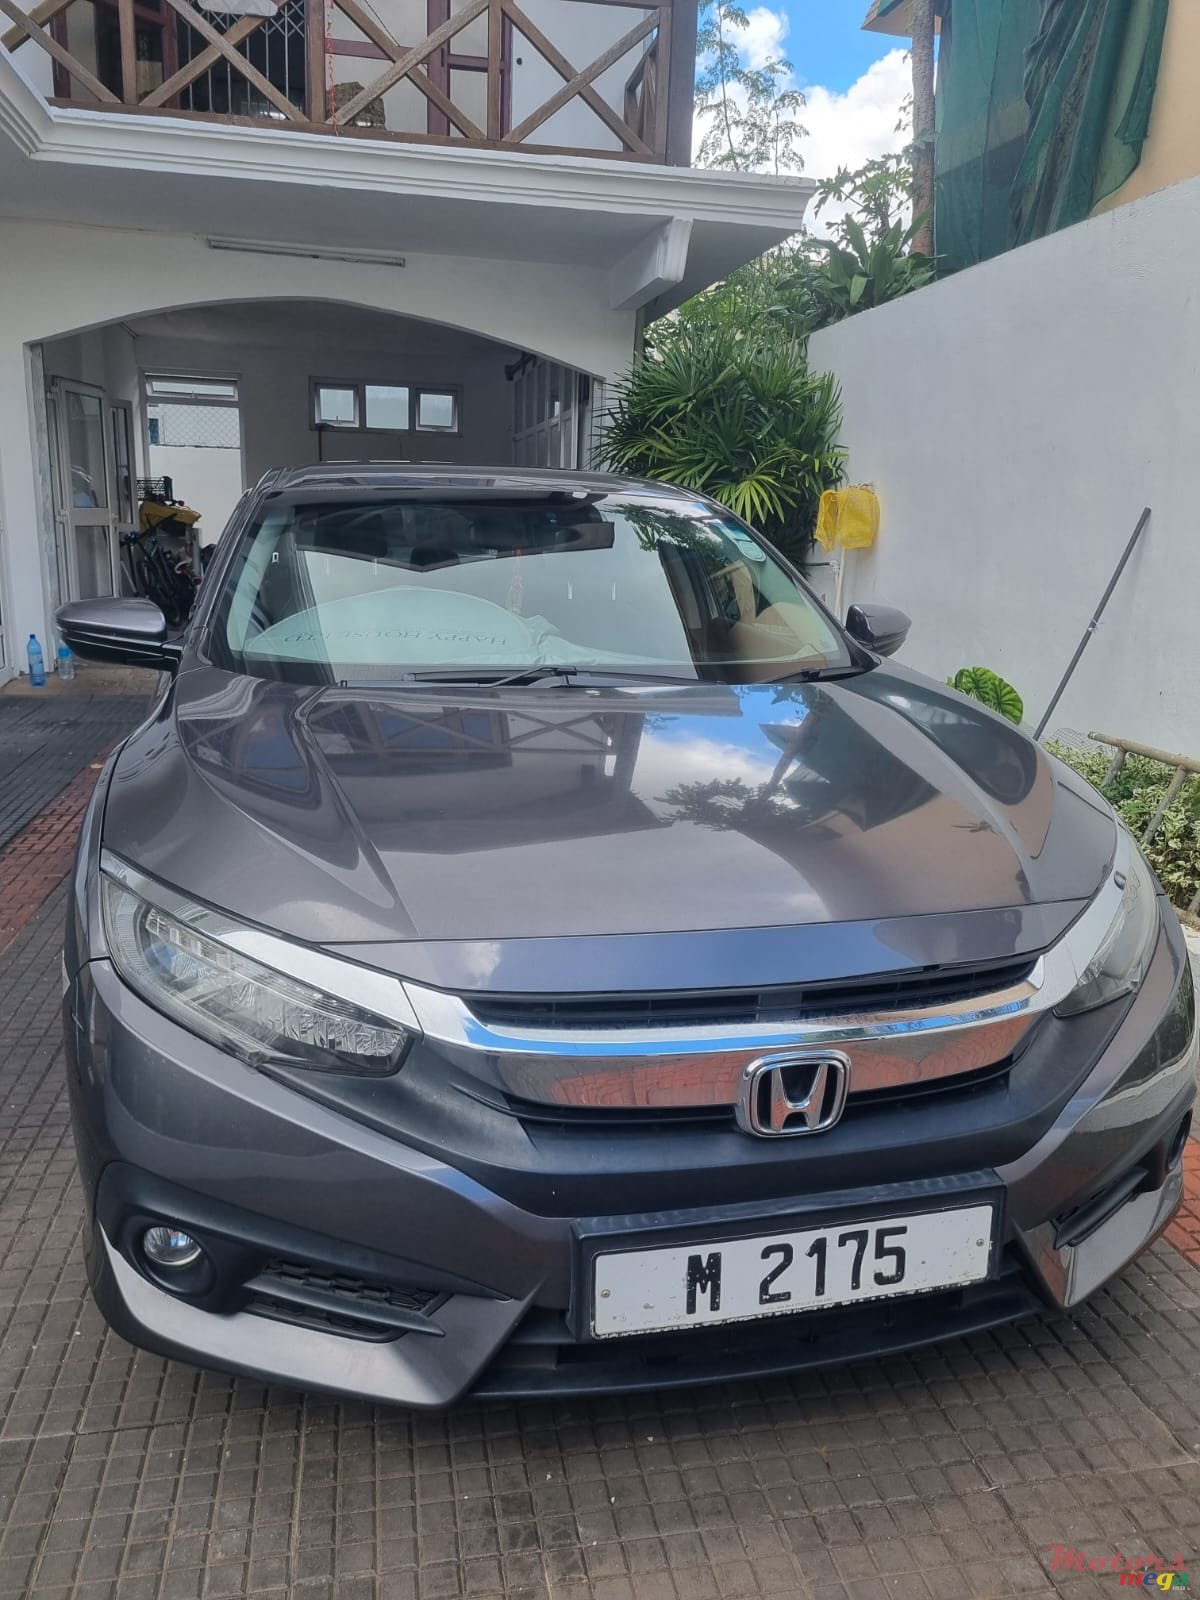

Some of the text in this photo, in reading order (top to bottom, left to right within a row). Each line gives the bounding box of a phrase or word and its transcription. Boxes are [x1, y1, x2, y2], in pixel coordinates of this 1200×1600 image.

[429, 631, 506, 646] HAPPY
[686, 1226, 907, 1315] M 2175
